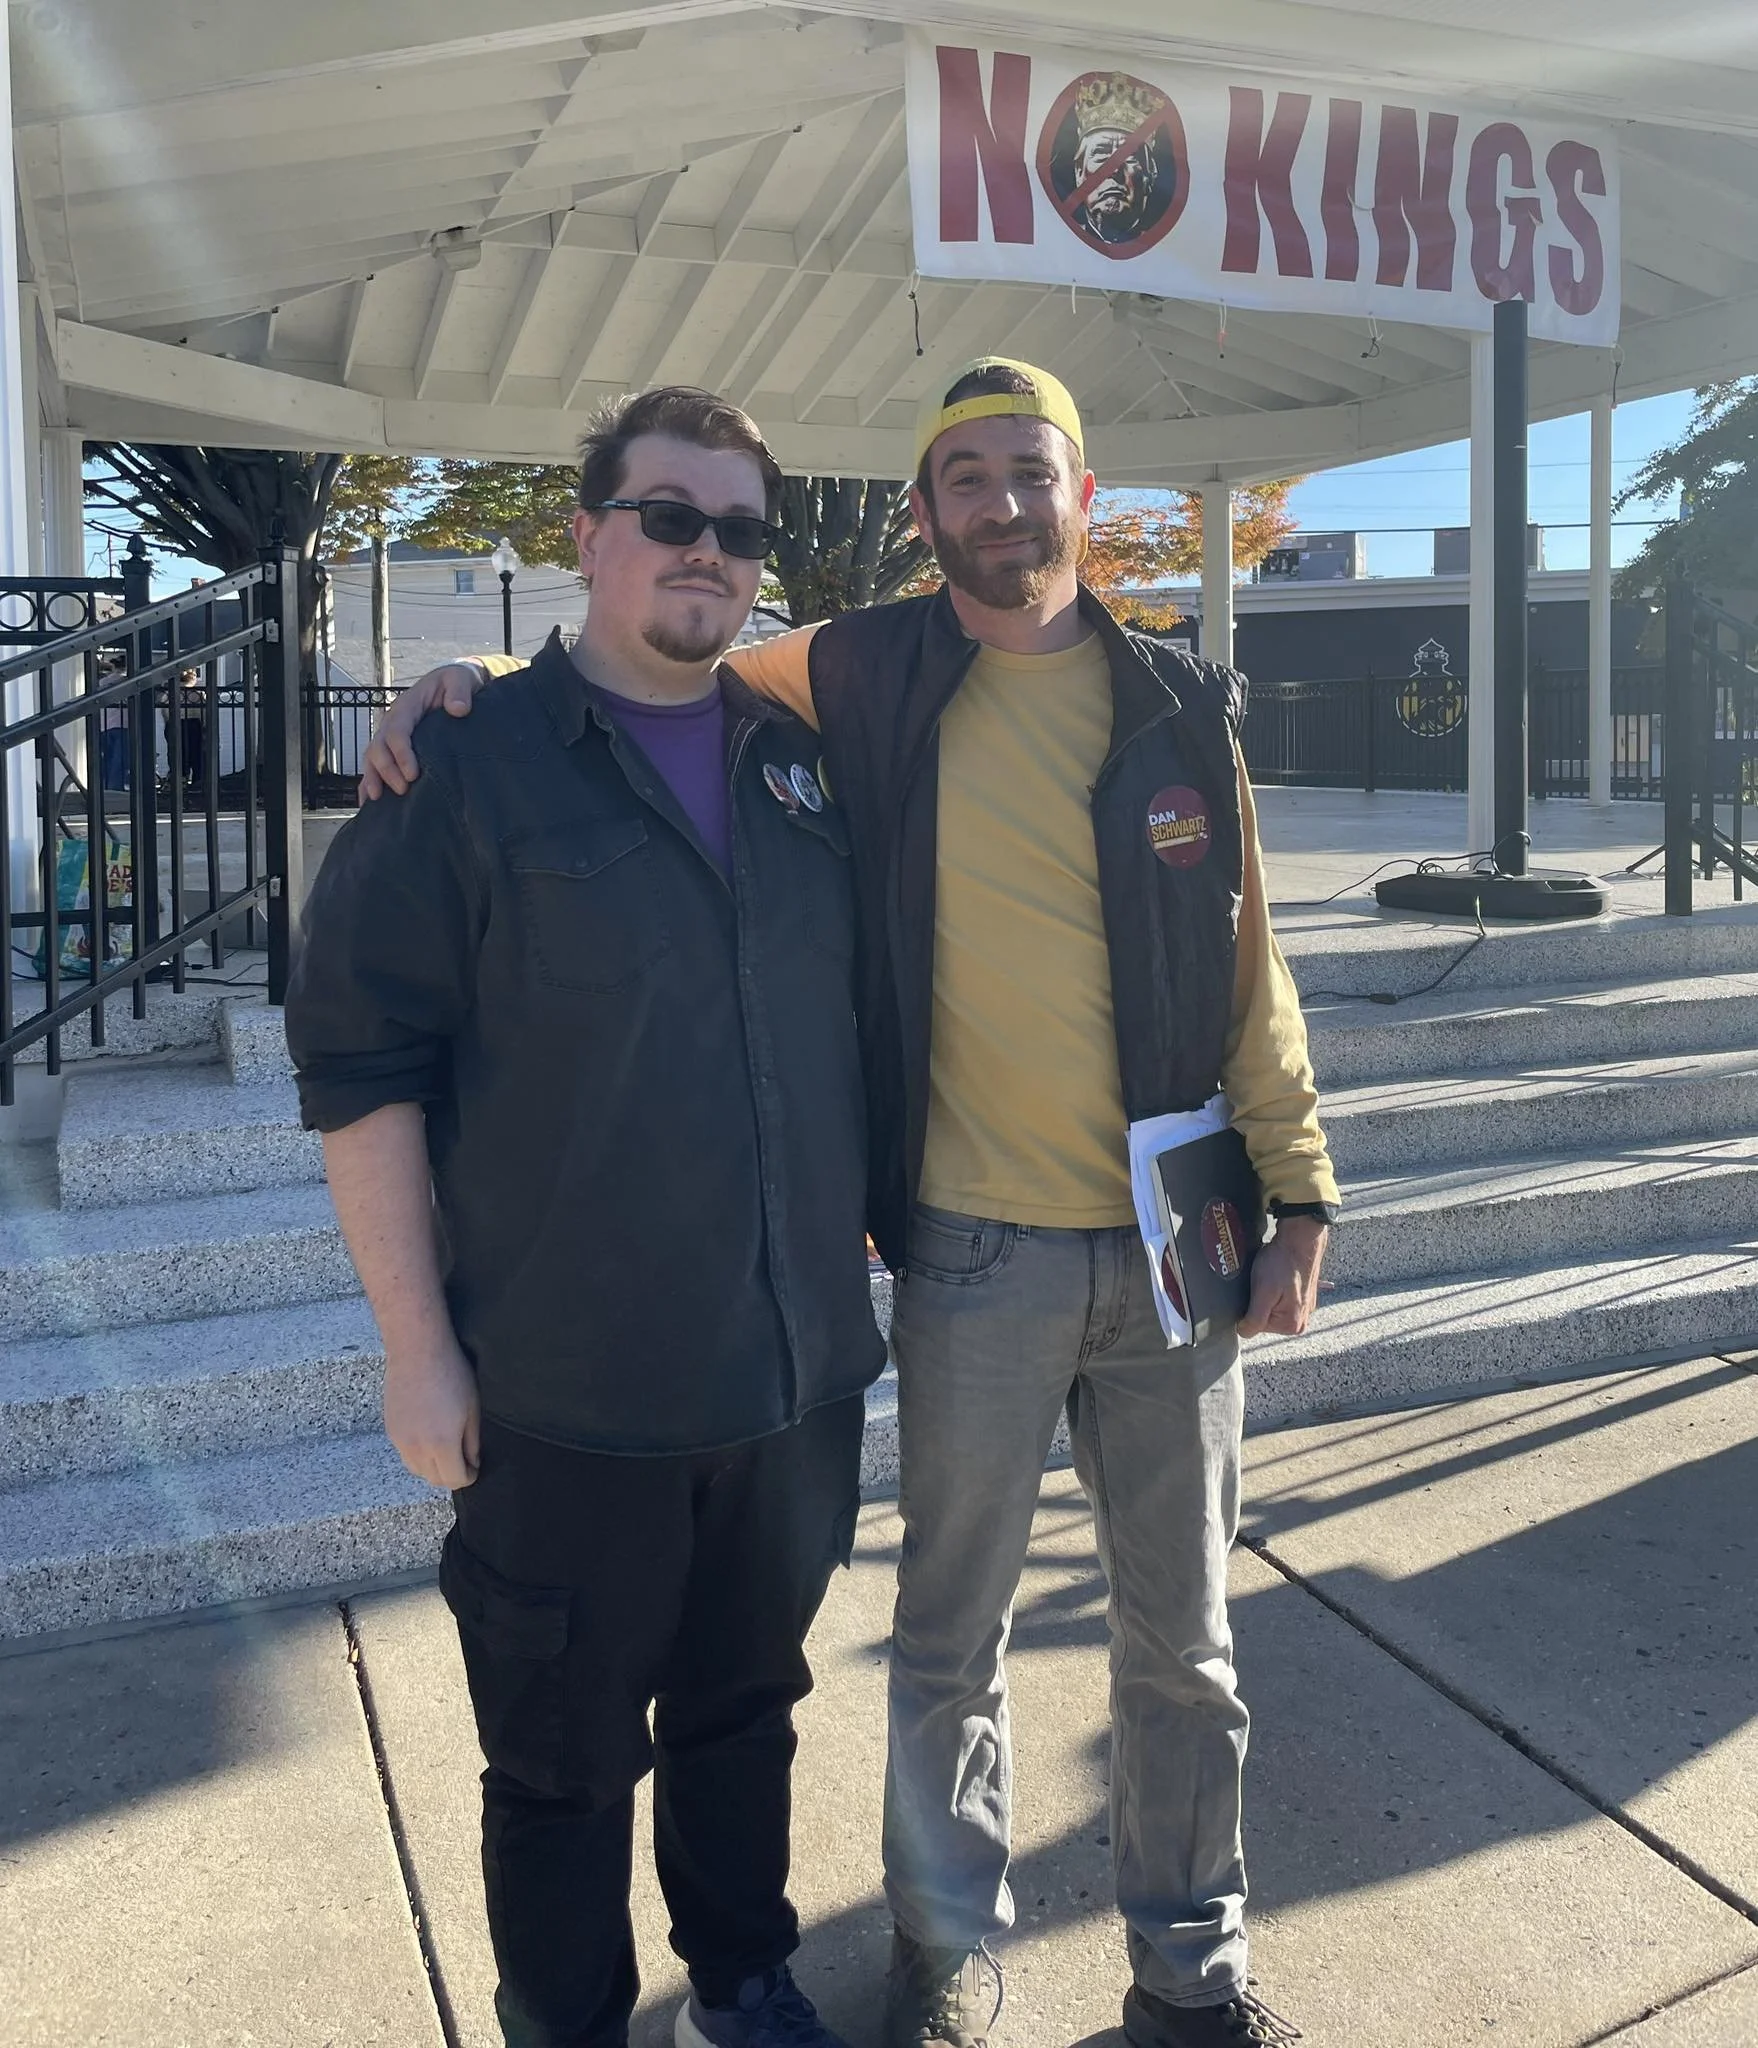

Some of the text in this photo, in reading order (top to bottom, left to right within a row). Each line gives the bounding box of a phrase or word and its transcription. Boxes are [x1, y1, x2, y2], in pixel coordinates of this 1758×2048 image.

[1221, 86, 1606, 316] KINGS
[1149, 810, 1177, 826] DAN
[1151, 815, 1207, 842] SCHWARTZ
[1212, 1202, 1236, 1272] SCHWARTZ
[1216, 1243, 1229, 1276] DAN
